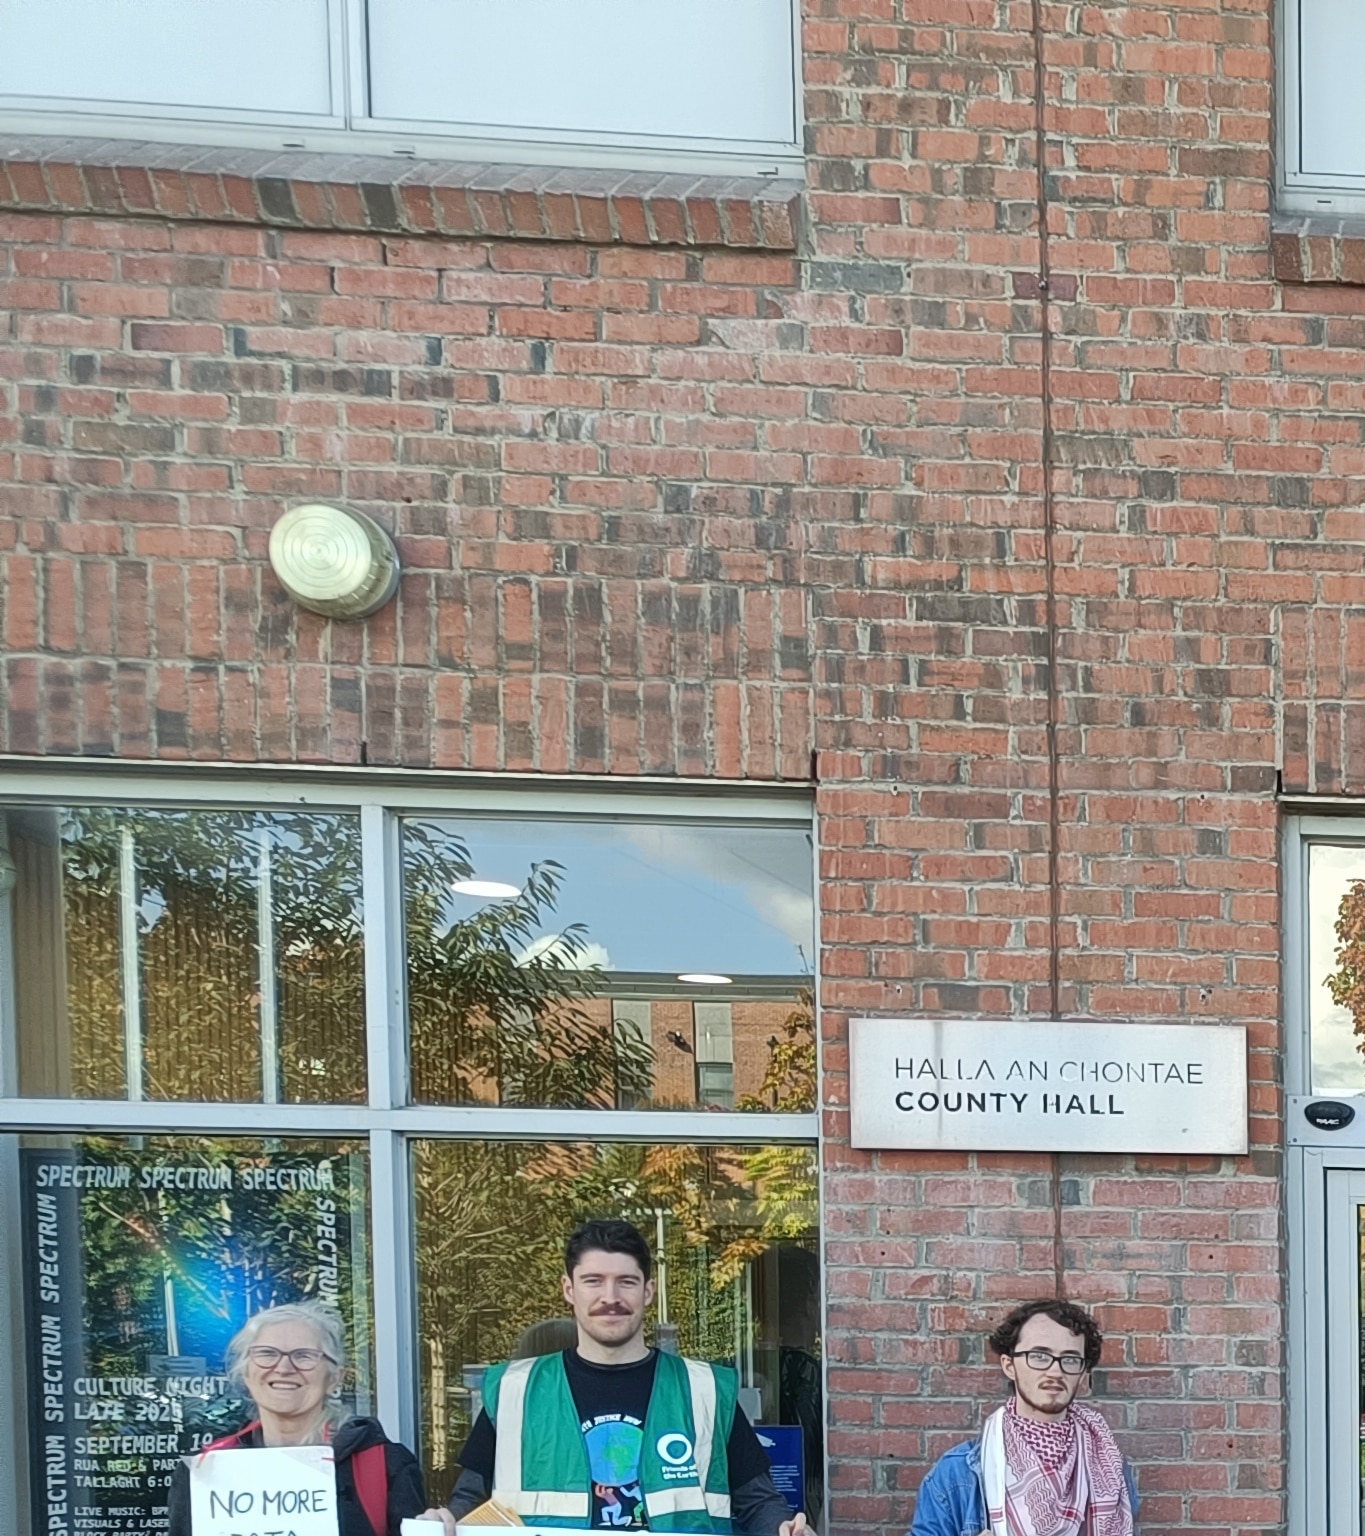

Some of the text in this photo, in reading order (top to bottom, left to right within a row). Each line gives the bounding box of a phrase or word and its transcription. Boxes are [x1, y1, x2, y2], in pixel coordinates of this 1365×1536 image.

[895, 1058, 1204, 1084] HALLA AN CHONTAE
[895, 1092, 1125, 1115] COUNTY HALL
[36, 1165, 131, 1188] SPECTRUM
[139, 1166, 232, 1190] SPECTRUM
[36, 1193, 60, 1304] SPECTRUM
[41, 1315, 65, 1422] SPECTRUM
[74, 1377, 228, 1396] CULTURE NIGHT
[74, 1402, 125, 1421] LATE
[74, 1459, 100, 1472] RUA
[107, 1459, 131, 1472] RED
[74, 1476, 141, 1488] TALLAGHT
[74, 1507, 103, 1516] LIVE
[210, 1489, 328, 1519] NO MORE
[73, 1519, 121, 1528] VISUALS
